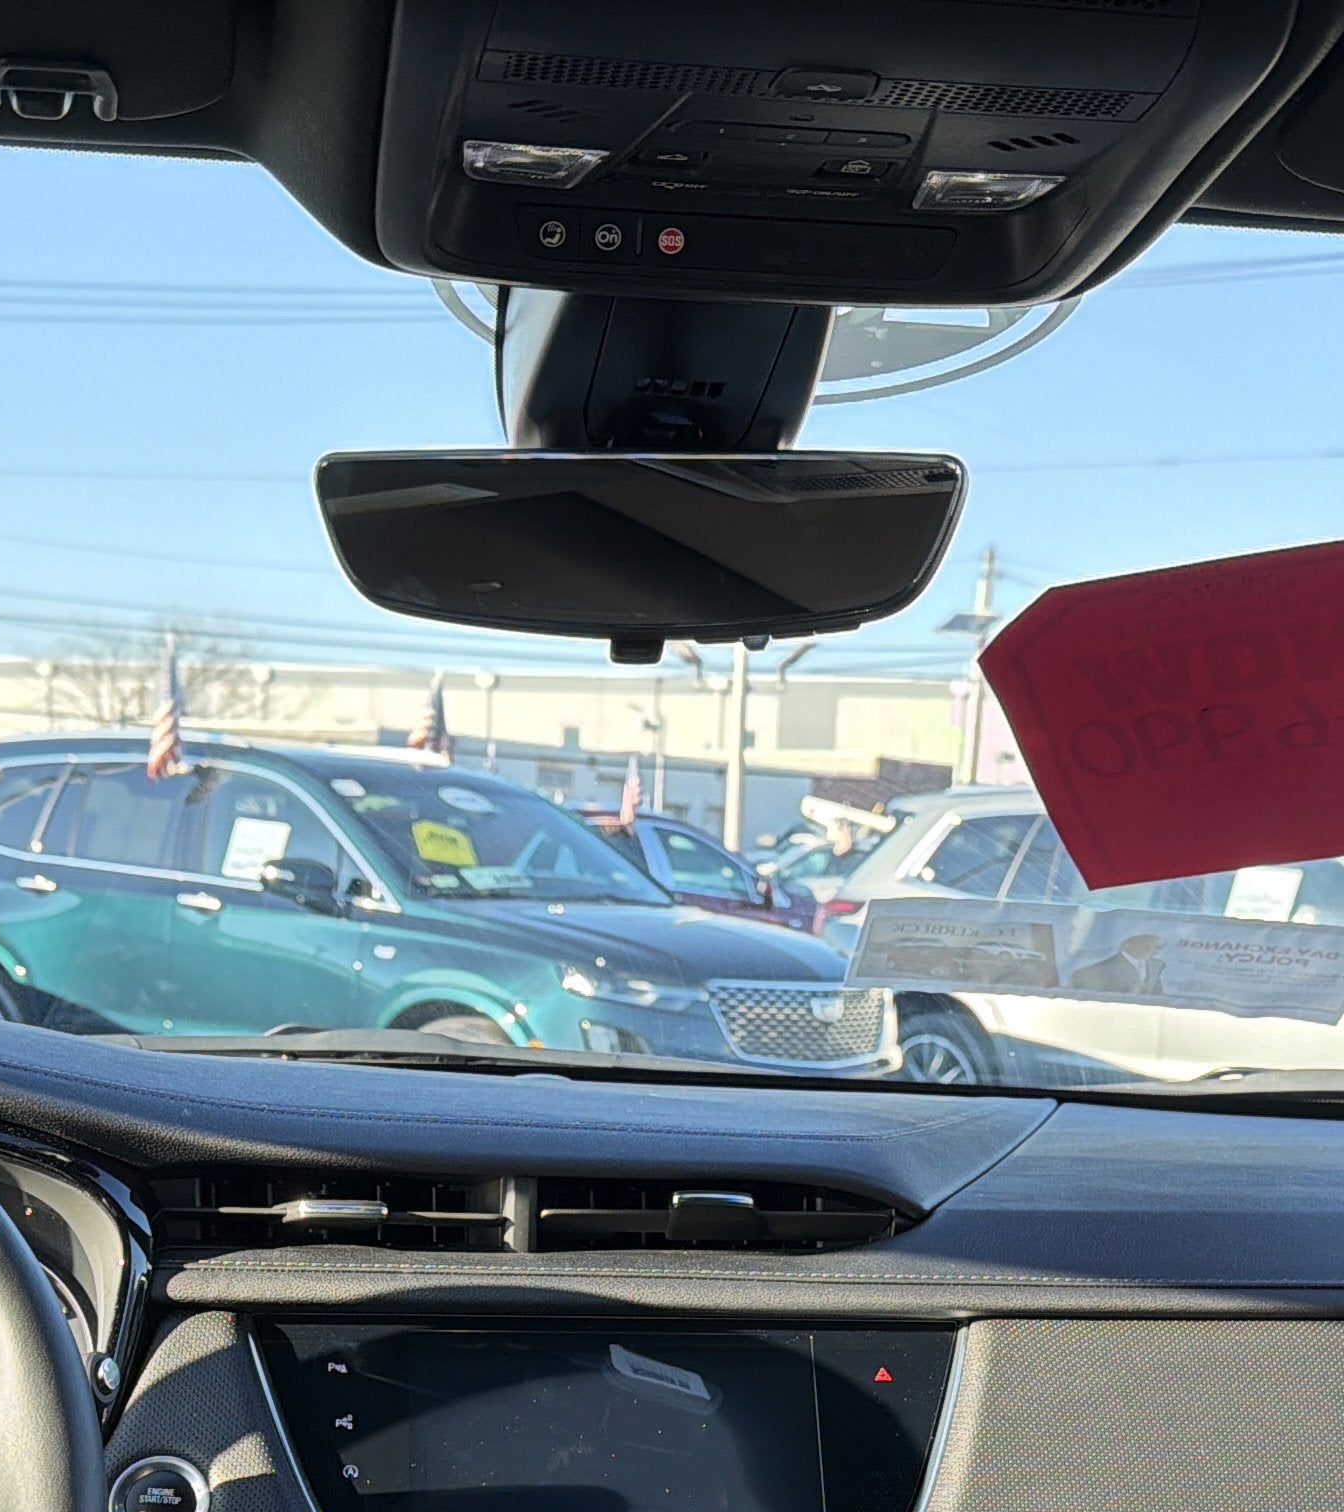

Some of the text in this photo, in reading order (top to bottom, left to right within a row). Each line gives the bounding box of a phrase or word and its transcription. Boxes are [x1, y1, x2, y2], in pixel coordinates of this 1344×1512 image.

[661, 234, 682, 247] SOS
[147, 1487, 176, 1497] ENGINE
[139, 1494, 183, 1505] START/STOP
